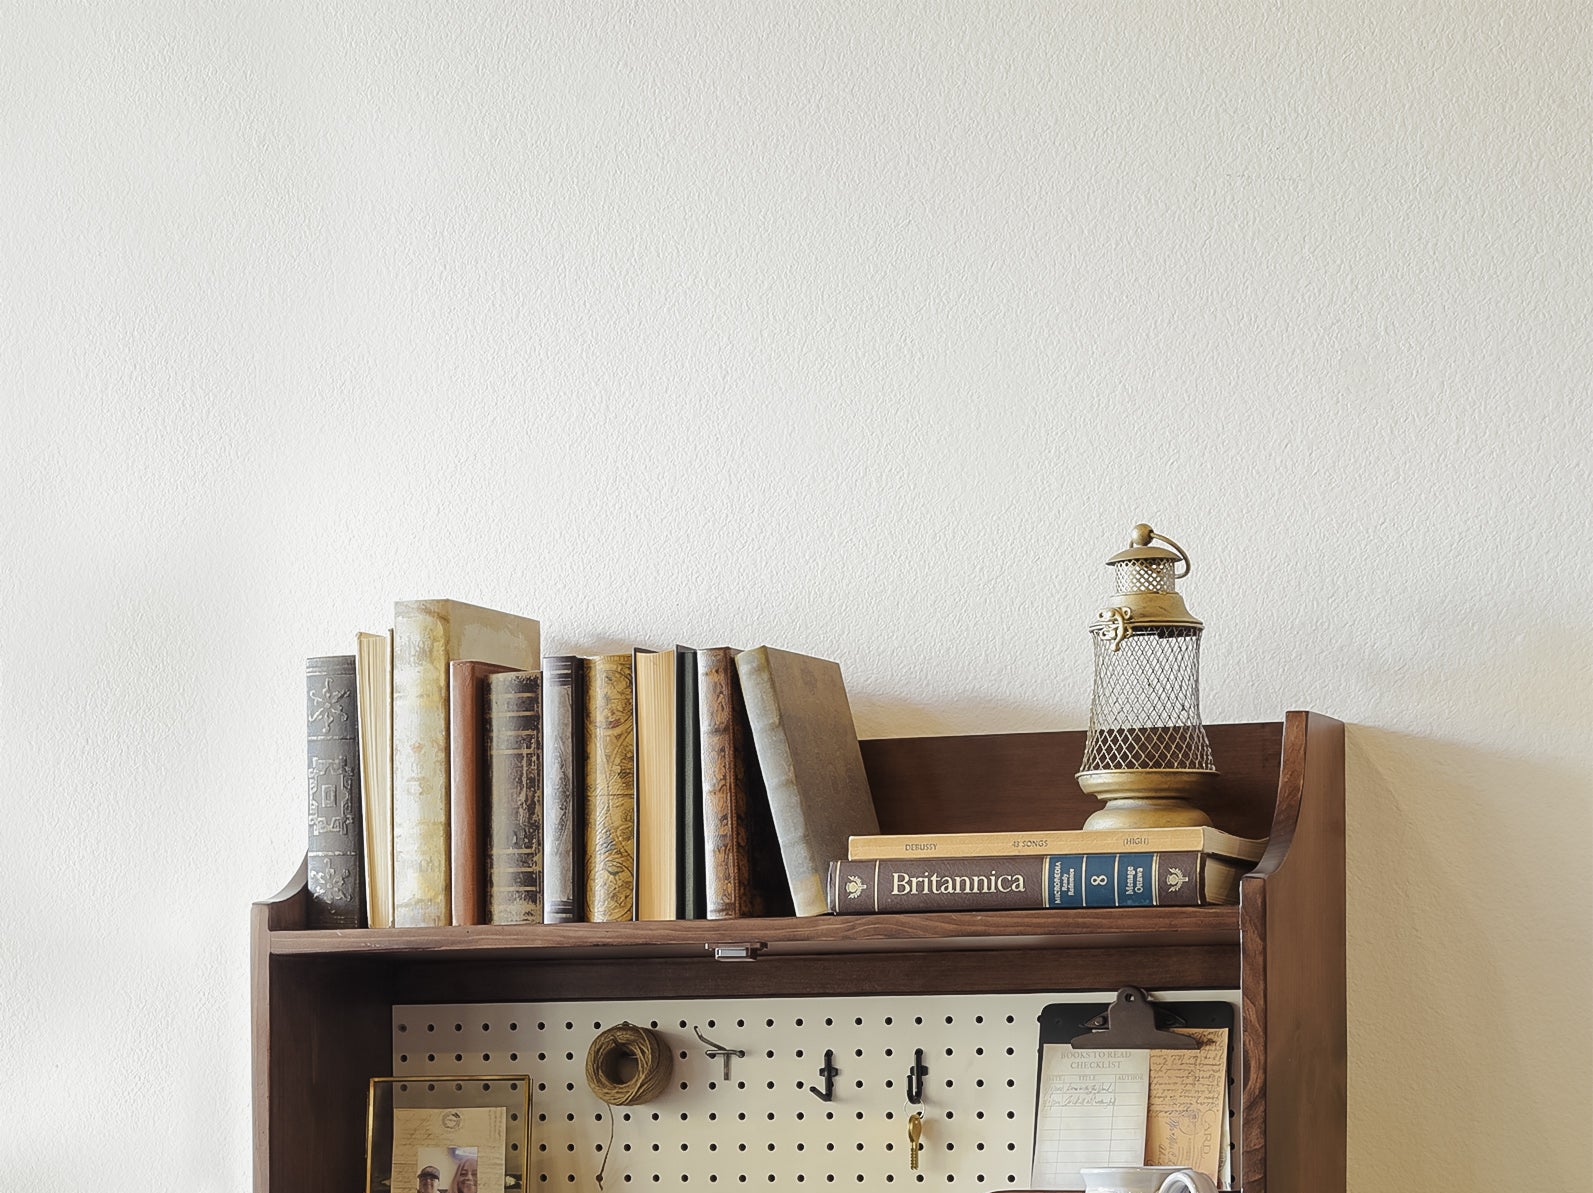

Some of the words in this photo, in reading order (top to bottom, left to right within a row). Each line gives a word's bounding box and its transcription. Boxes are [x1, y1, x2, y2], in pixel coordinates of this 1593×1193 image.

[1012, 840, 1021, 848] 43
[1022, 839, 1048, 848] SONGS
[1123, 837, 1149, 846] (HIGH)
[905, 843, 938, 852] DEBUSSY
[892, 870, 1026, 896] Britannica
[1061, 873, 1069, 891] Ready
[1090, 875, 1108, 886] 8
[1126, 866, 1135, 895] Menage
[1135, 867, 1144, 893] Ottawa
[1061, 1051, 1089, 1060] BOOKS
[1092, 1051, 1105, 1059] TO
[1107, 1050, 1132, 1058] READ
[1070, 1060, 1121, 1069] CHECKLIST
